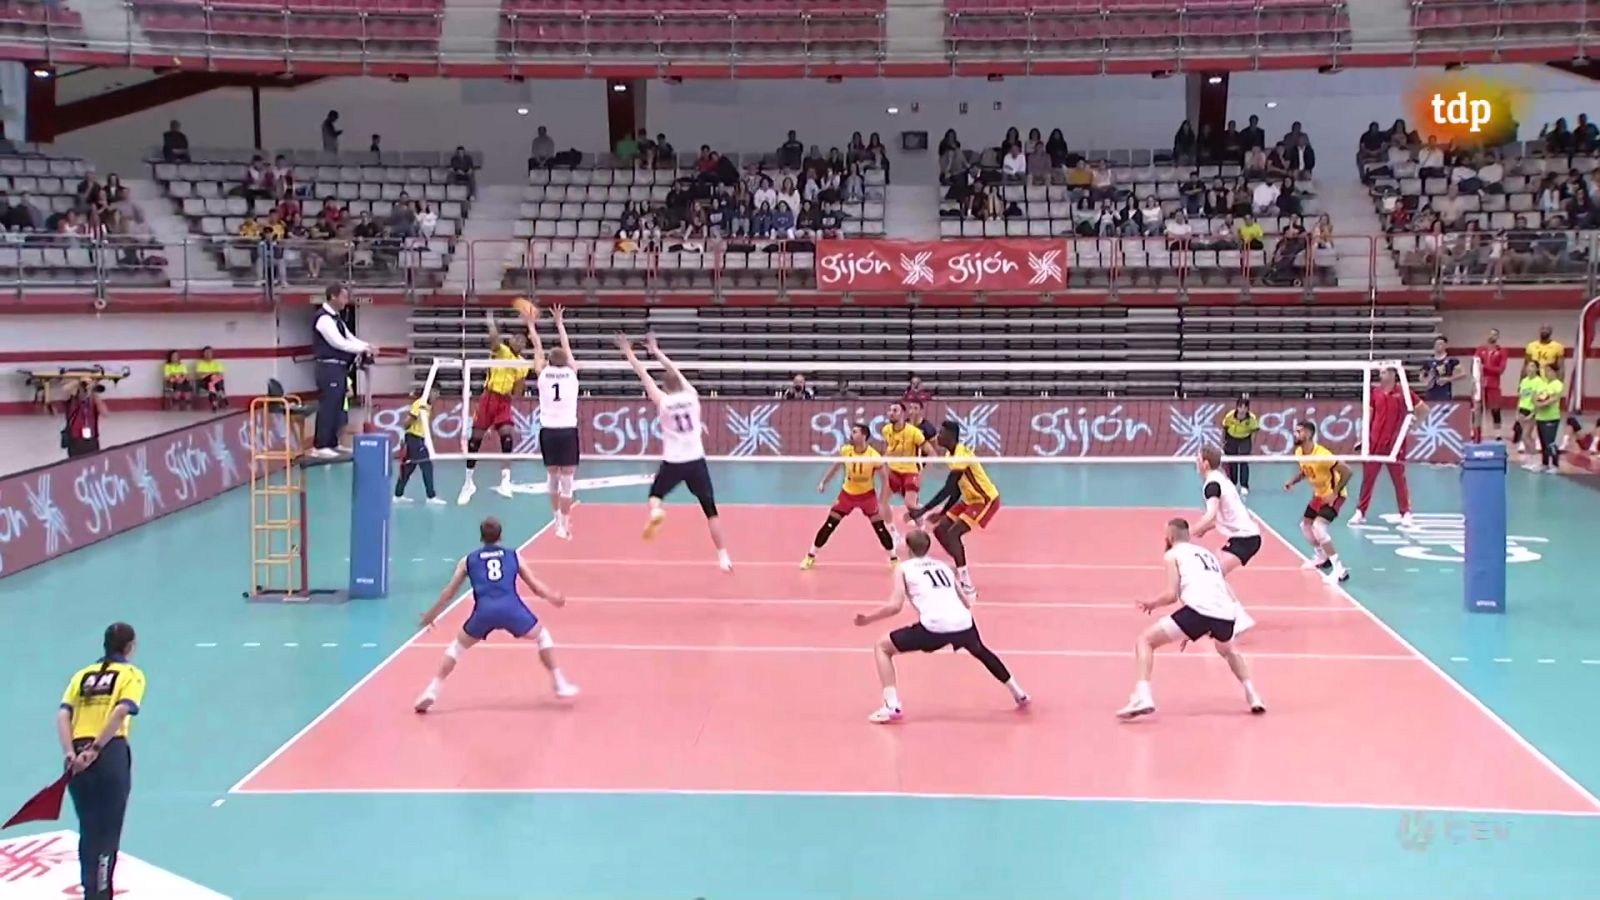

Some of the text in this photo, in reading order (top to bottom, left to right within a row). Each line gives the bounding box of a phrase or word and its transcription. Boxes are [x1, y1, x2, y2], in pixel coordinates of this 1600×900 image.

[821, 251, 1019, 284] gijón gijón
[552, 383, 562, 401] 1
[1031, 405, 1152, 457] gijón
[165, 433, 210, 500] gijón
[75, 457, 130, 534] gijón
[487, 560, 502, 580] 8
[923, 569, 951, 588] 10
